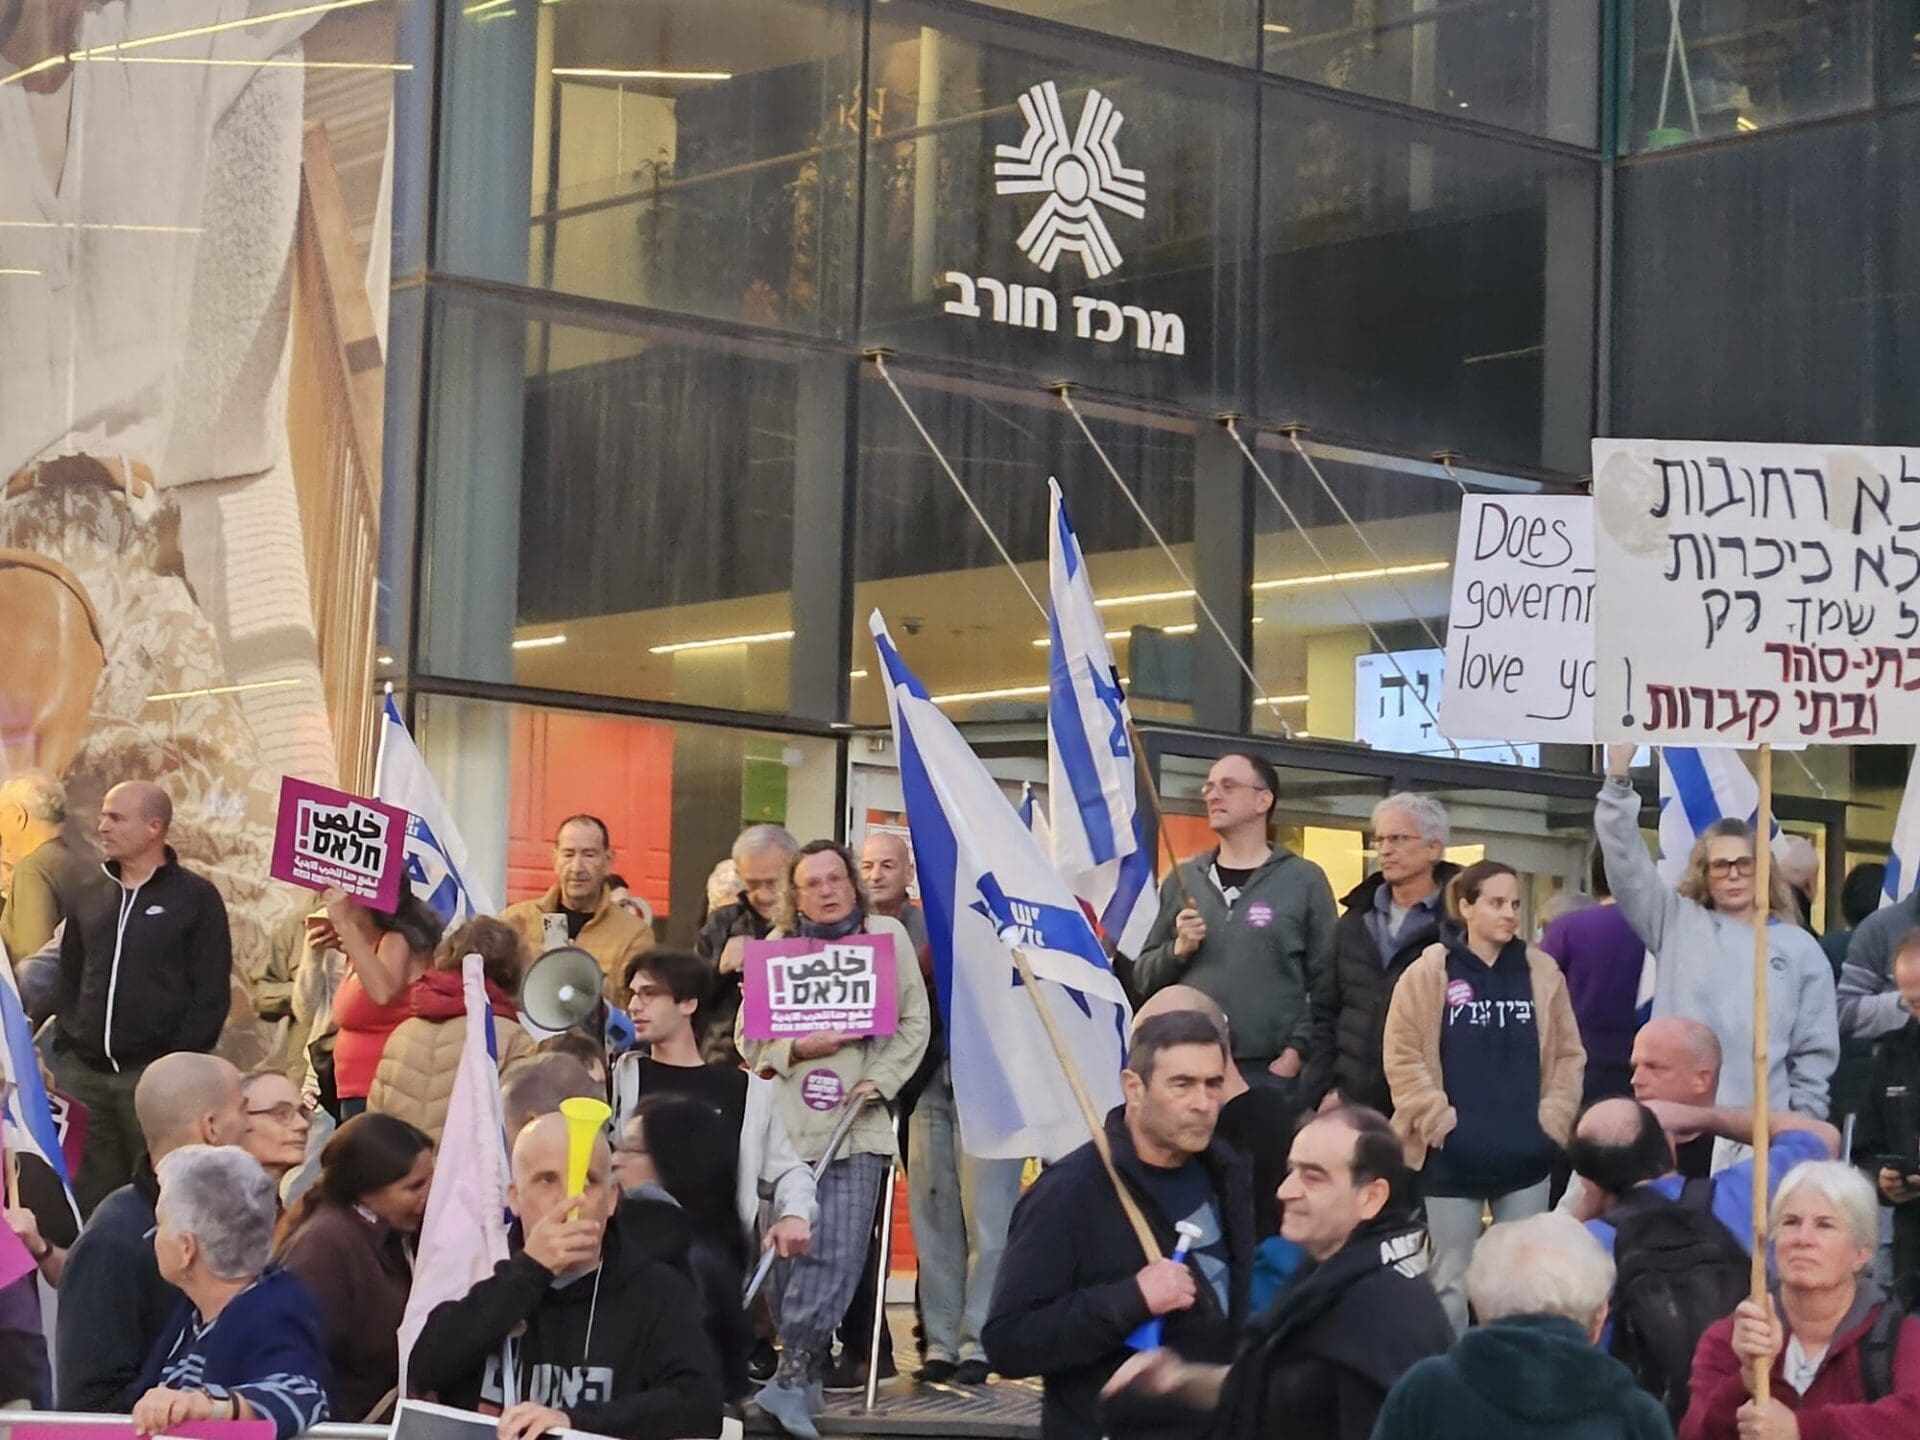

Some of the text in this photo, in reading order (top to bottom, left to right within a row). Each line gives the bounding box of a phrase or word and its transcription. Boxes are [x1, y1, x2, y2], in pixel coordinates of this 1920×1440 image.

[944, 271, 1185, 355] מרכז חורב
[1649, 457, 1829, 520] רחובות
[1475, 503, 1573, 568] Does
[1664, 534, 1920, 594] לא כיכרות
[1702, 589, 1762, 649] רק
[1459, 634, 1524, 693] love
[1794, 689, 1878, 738] ובתי
[313, 809, 381, 838] خلص
[787, 949, 867, 980] خلص
